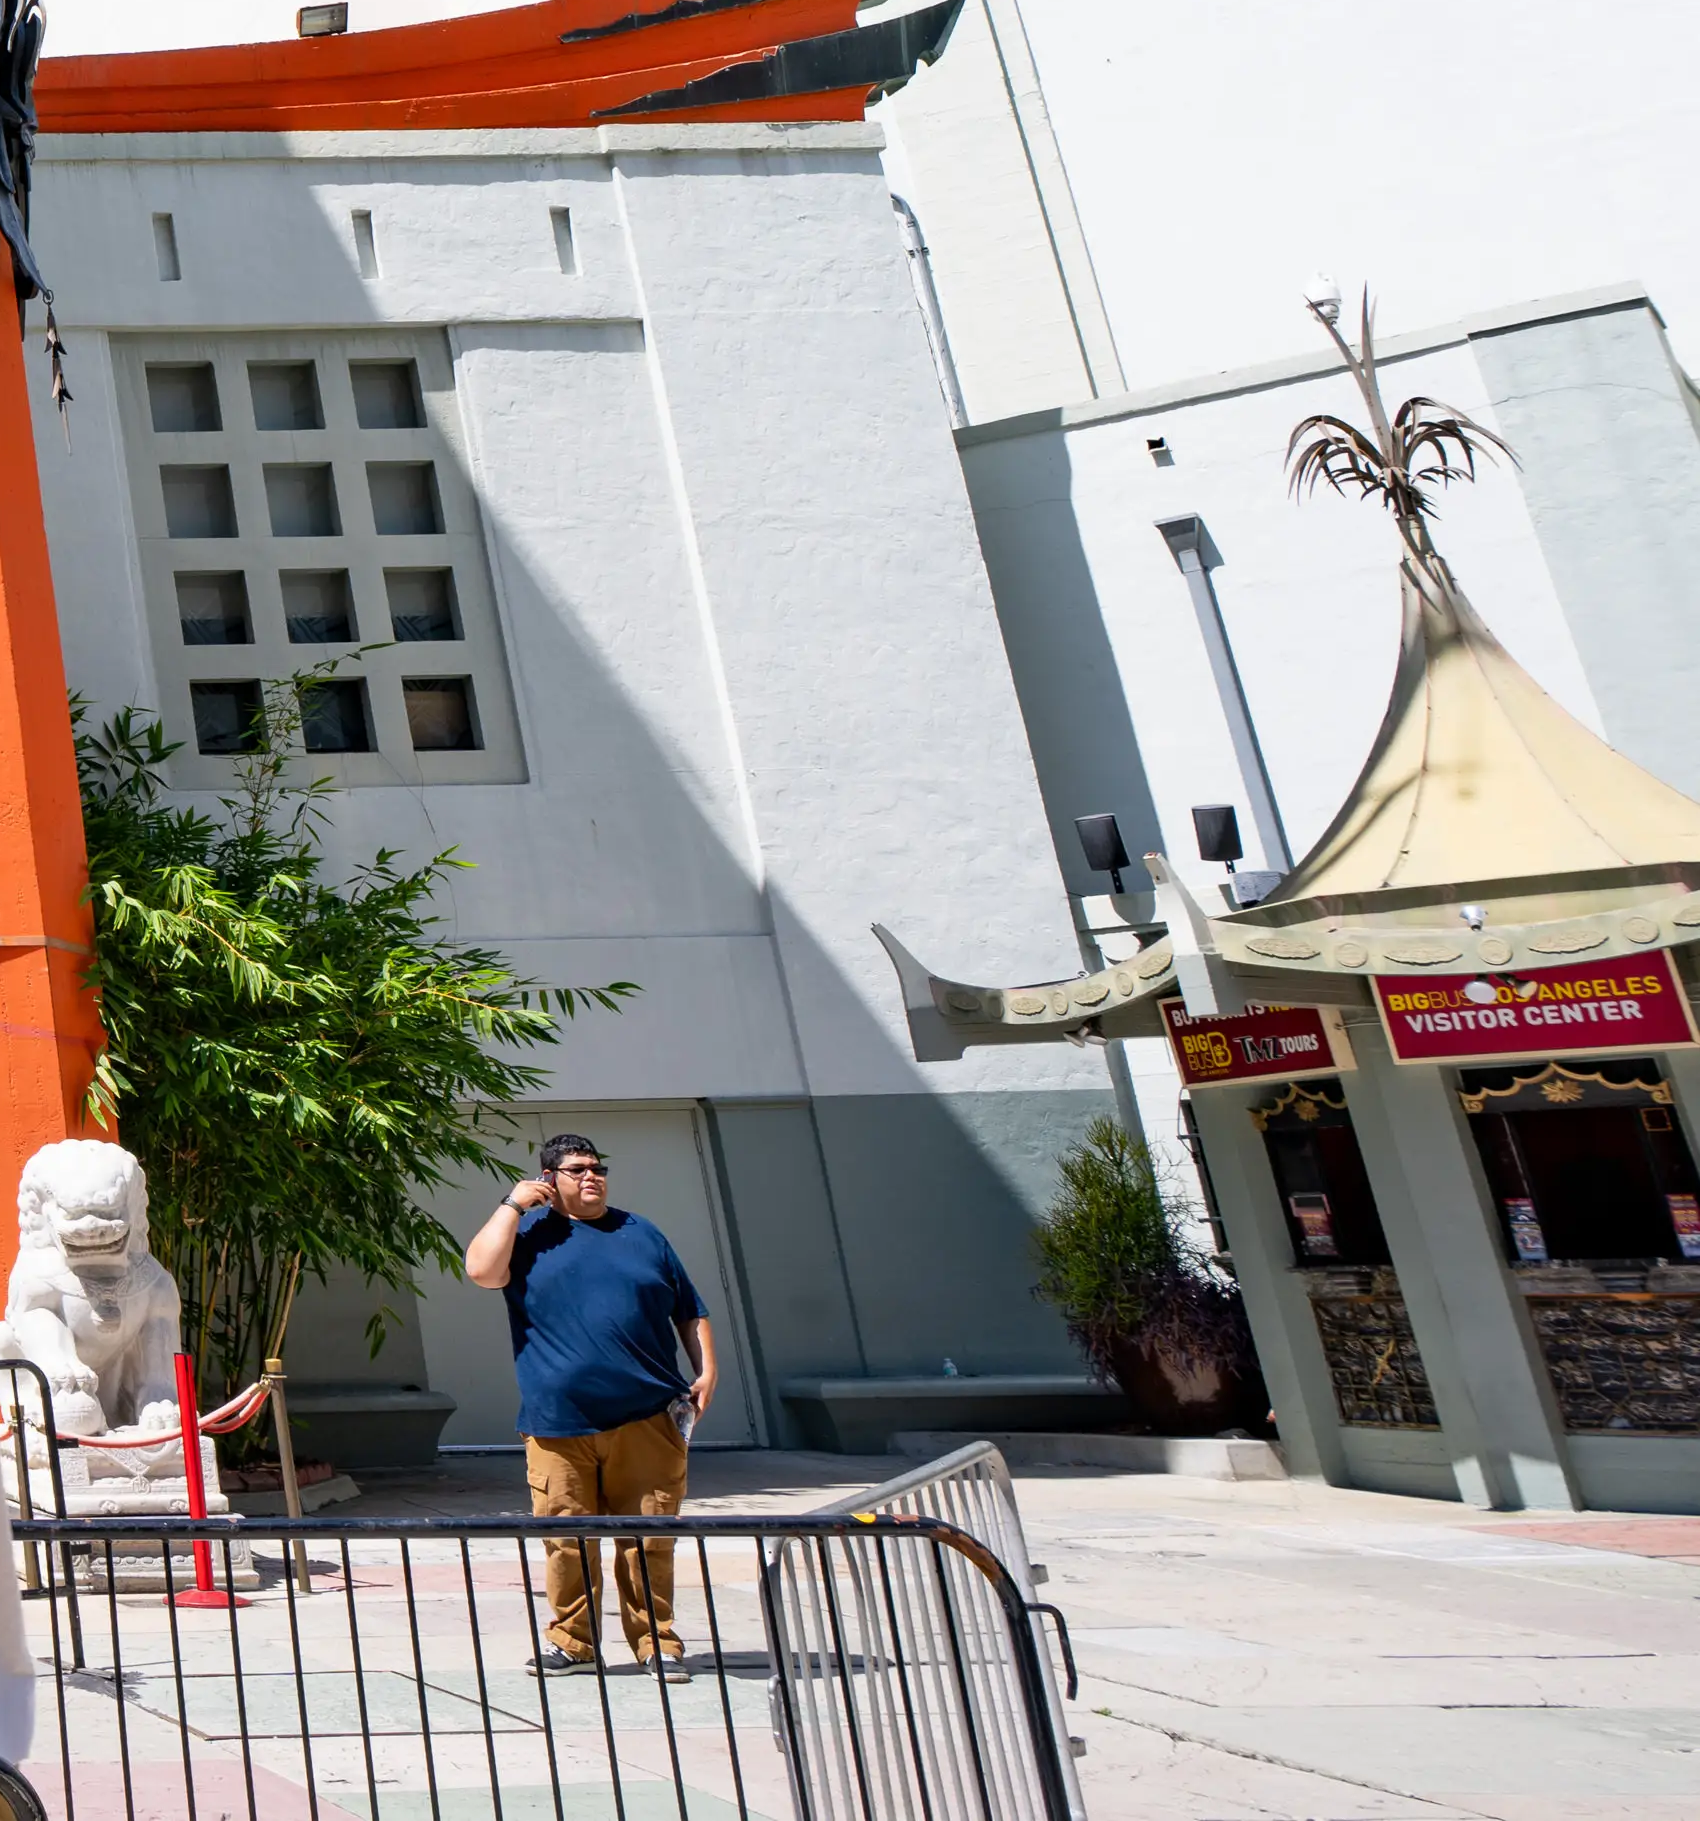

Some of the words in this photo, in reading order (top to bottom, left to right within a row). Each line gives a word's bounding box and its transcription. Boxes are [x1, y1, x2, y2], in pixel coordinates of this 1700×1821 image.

[1537, 975, 1663, 1002] ANGELES
[1404, 1008, 1517, 1033] VISITOR
[1523, 1000, 1643, 1026] CENTER
[1181, 1034, 1208, 1053] BIG
[1233, 1035, 1285, 1064] TMZ
[1280, 1033, 1320, 1054] TOURS
[1187, 1053, 1214, 1071] BUS
